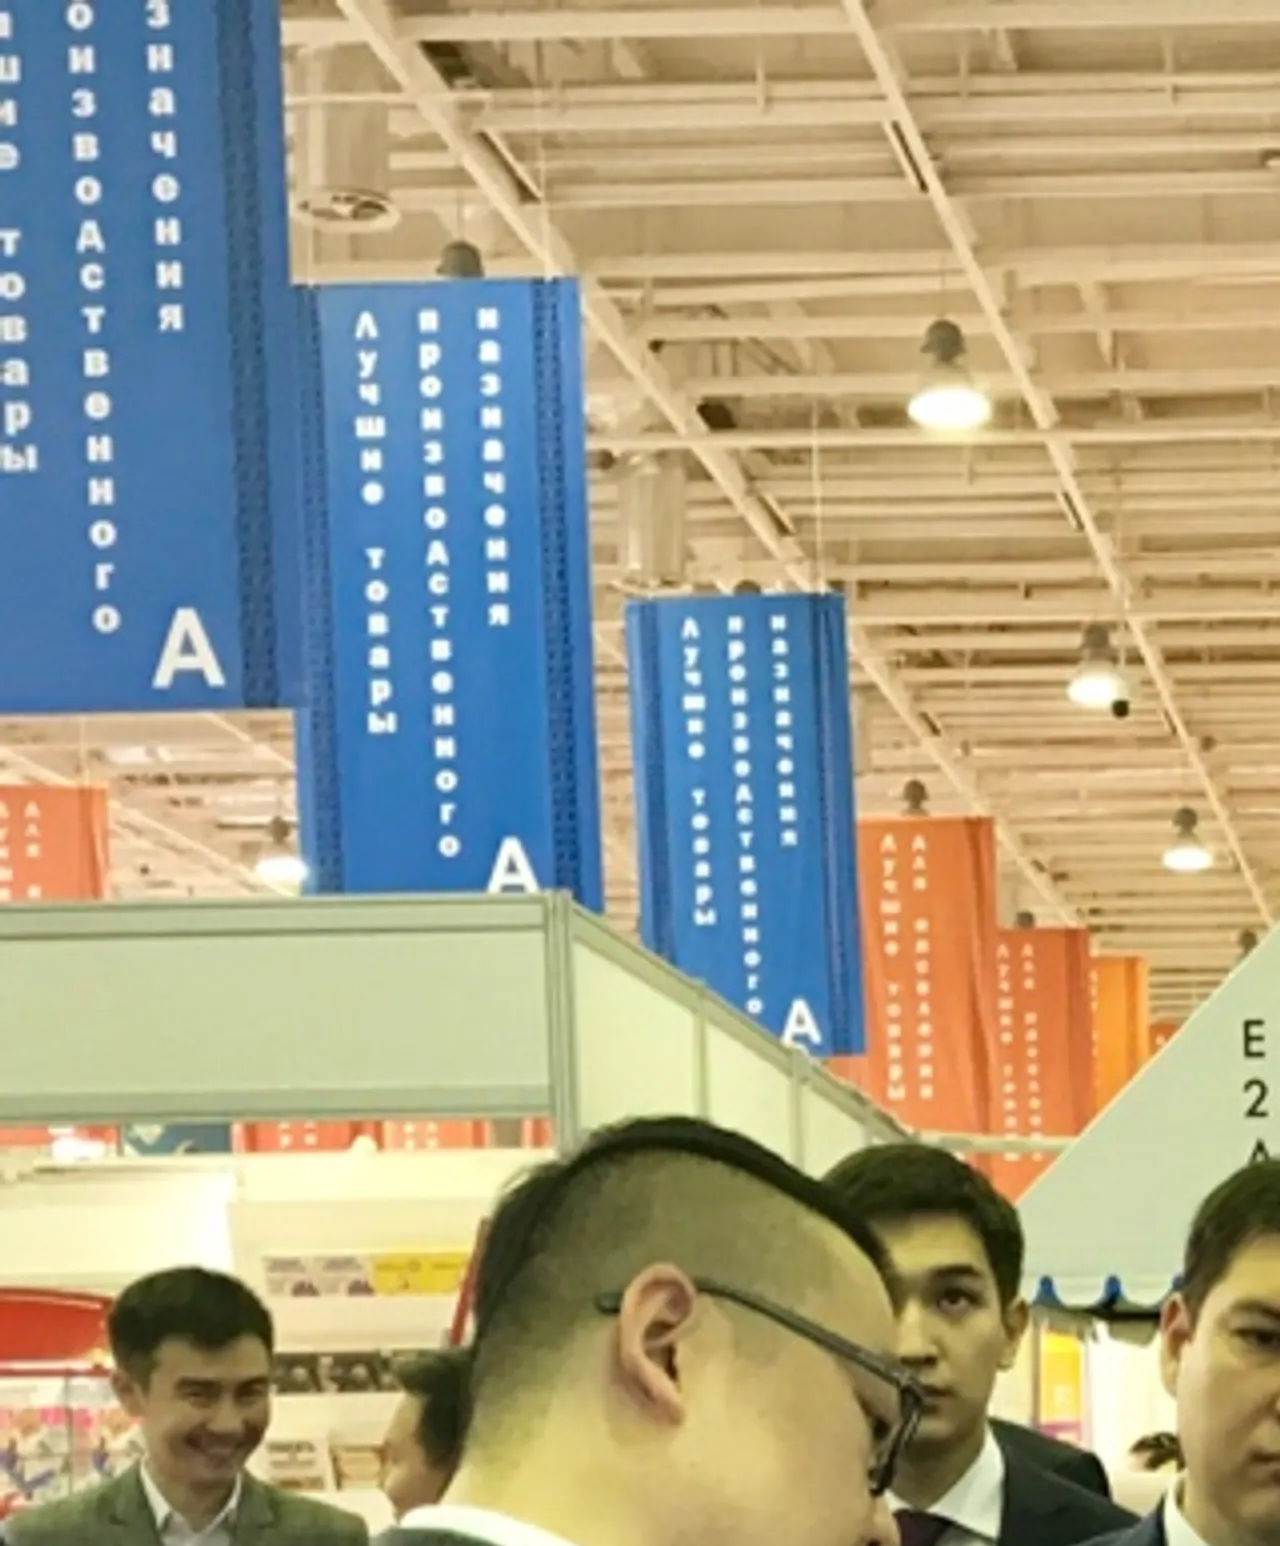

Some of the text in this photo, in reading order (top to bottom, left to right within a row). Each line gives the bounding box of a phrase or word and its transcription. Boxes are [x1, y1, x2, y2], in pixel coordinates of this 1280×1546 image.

[354, 310, 398, 735] Лучшие товары
[417, 307, 461, 859] производственного
[476, 306, 511, 627] назначения
